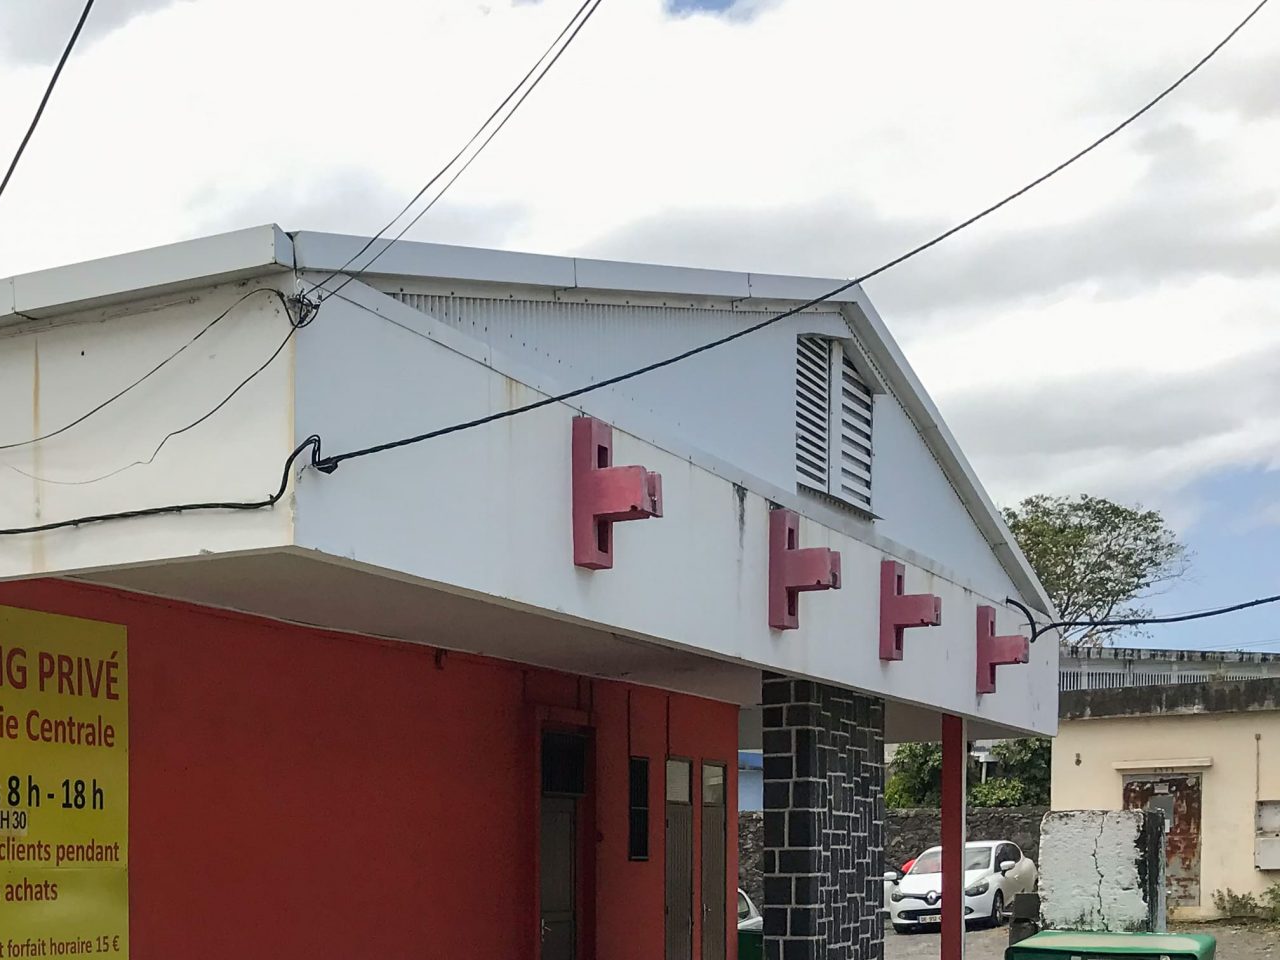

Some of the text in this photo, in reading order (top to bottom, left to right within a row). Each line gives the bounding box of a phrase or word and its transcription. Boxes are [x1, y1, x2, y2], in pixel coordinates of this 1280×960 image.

[38, 651, 120, 700] PRIVÉ
[26, 709, 116, 748] Centrale
[7, 776, 20, 807] 8
[28, 775, 40, 807] h
[62, 778, 86, 809] 18
[92, 779, 104, 810] h
[12, 811, 27, 829] 30
[56, 838, 120, 866] pendant
[5, 878, 58, 903] achats
[7, 938, 46, 959] forfait
[49, 936, 92, 956] horaire
[96, 936, 109, 953] 15
[112, 935, 120, 953] €
